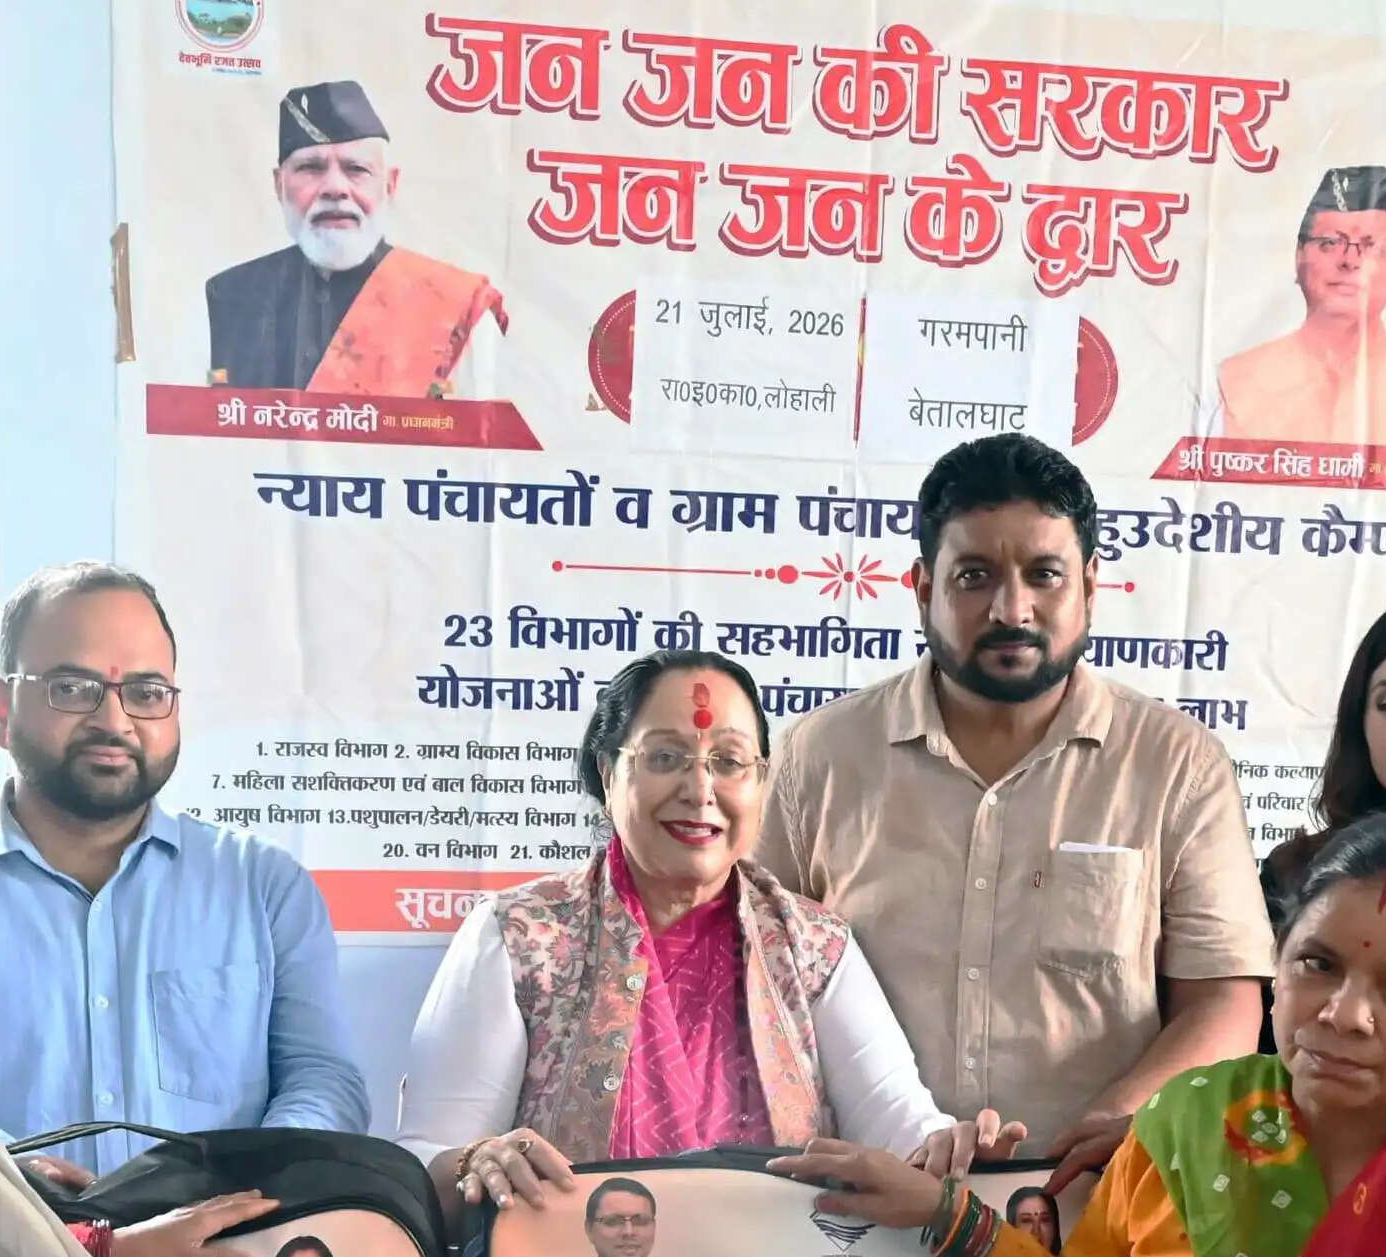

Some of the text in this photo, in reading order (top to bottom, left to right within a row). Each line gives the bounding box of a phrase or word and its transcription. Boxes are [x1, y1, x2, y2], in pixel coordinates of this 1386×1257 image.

[425, 12, 1289, 172] जन जन की सरकार
[528, 148, 1188, 297] जन जन के द्वार
[656, 296, 845, 337] 21 जुलाई, 2026
[918, 315, 1028, 352] गरमपानी
[218, 397, 246, 427] श्री
[253, 400, 320, 432] नरेन्द्र
[326, 403, 379, 432] मोदी
[909, 388, 1028, 432] बेतालघाट
[1177, 445, 1204, 471] श्री
[1210, 450, 1269, 478] पुष्कर
[1273, 448, 1313, 477] सिंह
[1318, 452, 1364, 478] धामी
[254, 472, 386, 519] न्याय
[405, 468, 599, 528] पंचायतों
[614, 490, 652, 529] व
[670, 490, 777, 536] ग्राम
[796, 485, 919, 540] पंचाय
[443, 615, 493, 648] 23
[509, 605, 638, 653] विभागों
[653, 612, 702, 652] की
[716, 618, 900, 661] सहभागिता
[416, 668, 584, 713] योजनाओं
[257, 739, 578, 761] 1. राजस्व विभाग 2. ग्राम्य विकास विभाग
[212, 771, 582, 795] 7. महिला सशक्तिकरण एवं बाल विकास विभाग
[1257, 792, 1304, 811] परिवार
[214, 807, 261, 828] आयुष
[268, 805, 321, 824] विभाग
[525, 807, 576, 827] विभाग
[383, 840, 591, 860] 20. वन विभाग 21. कौशल
